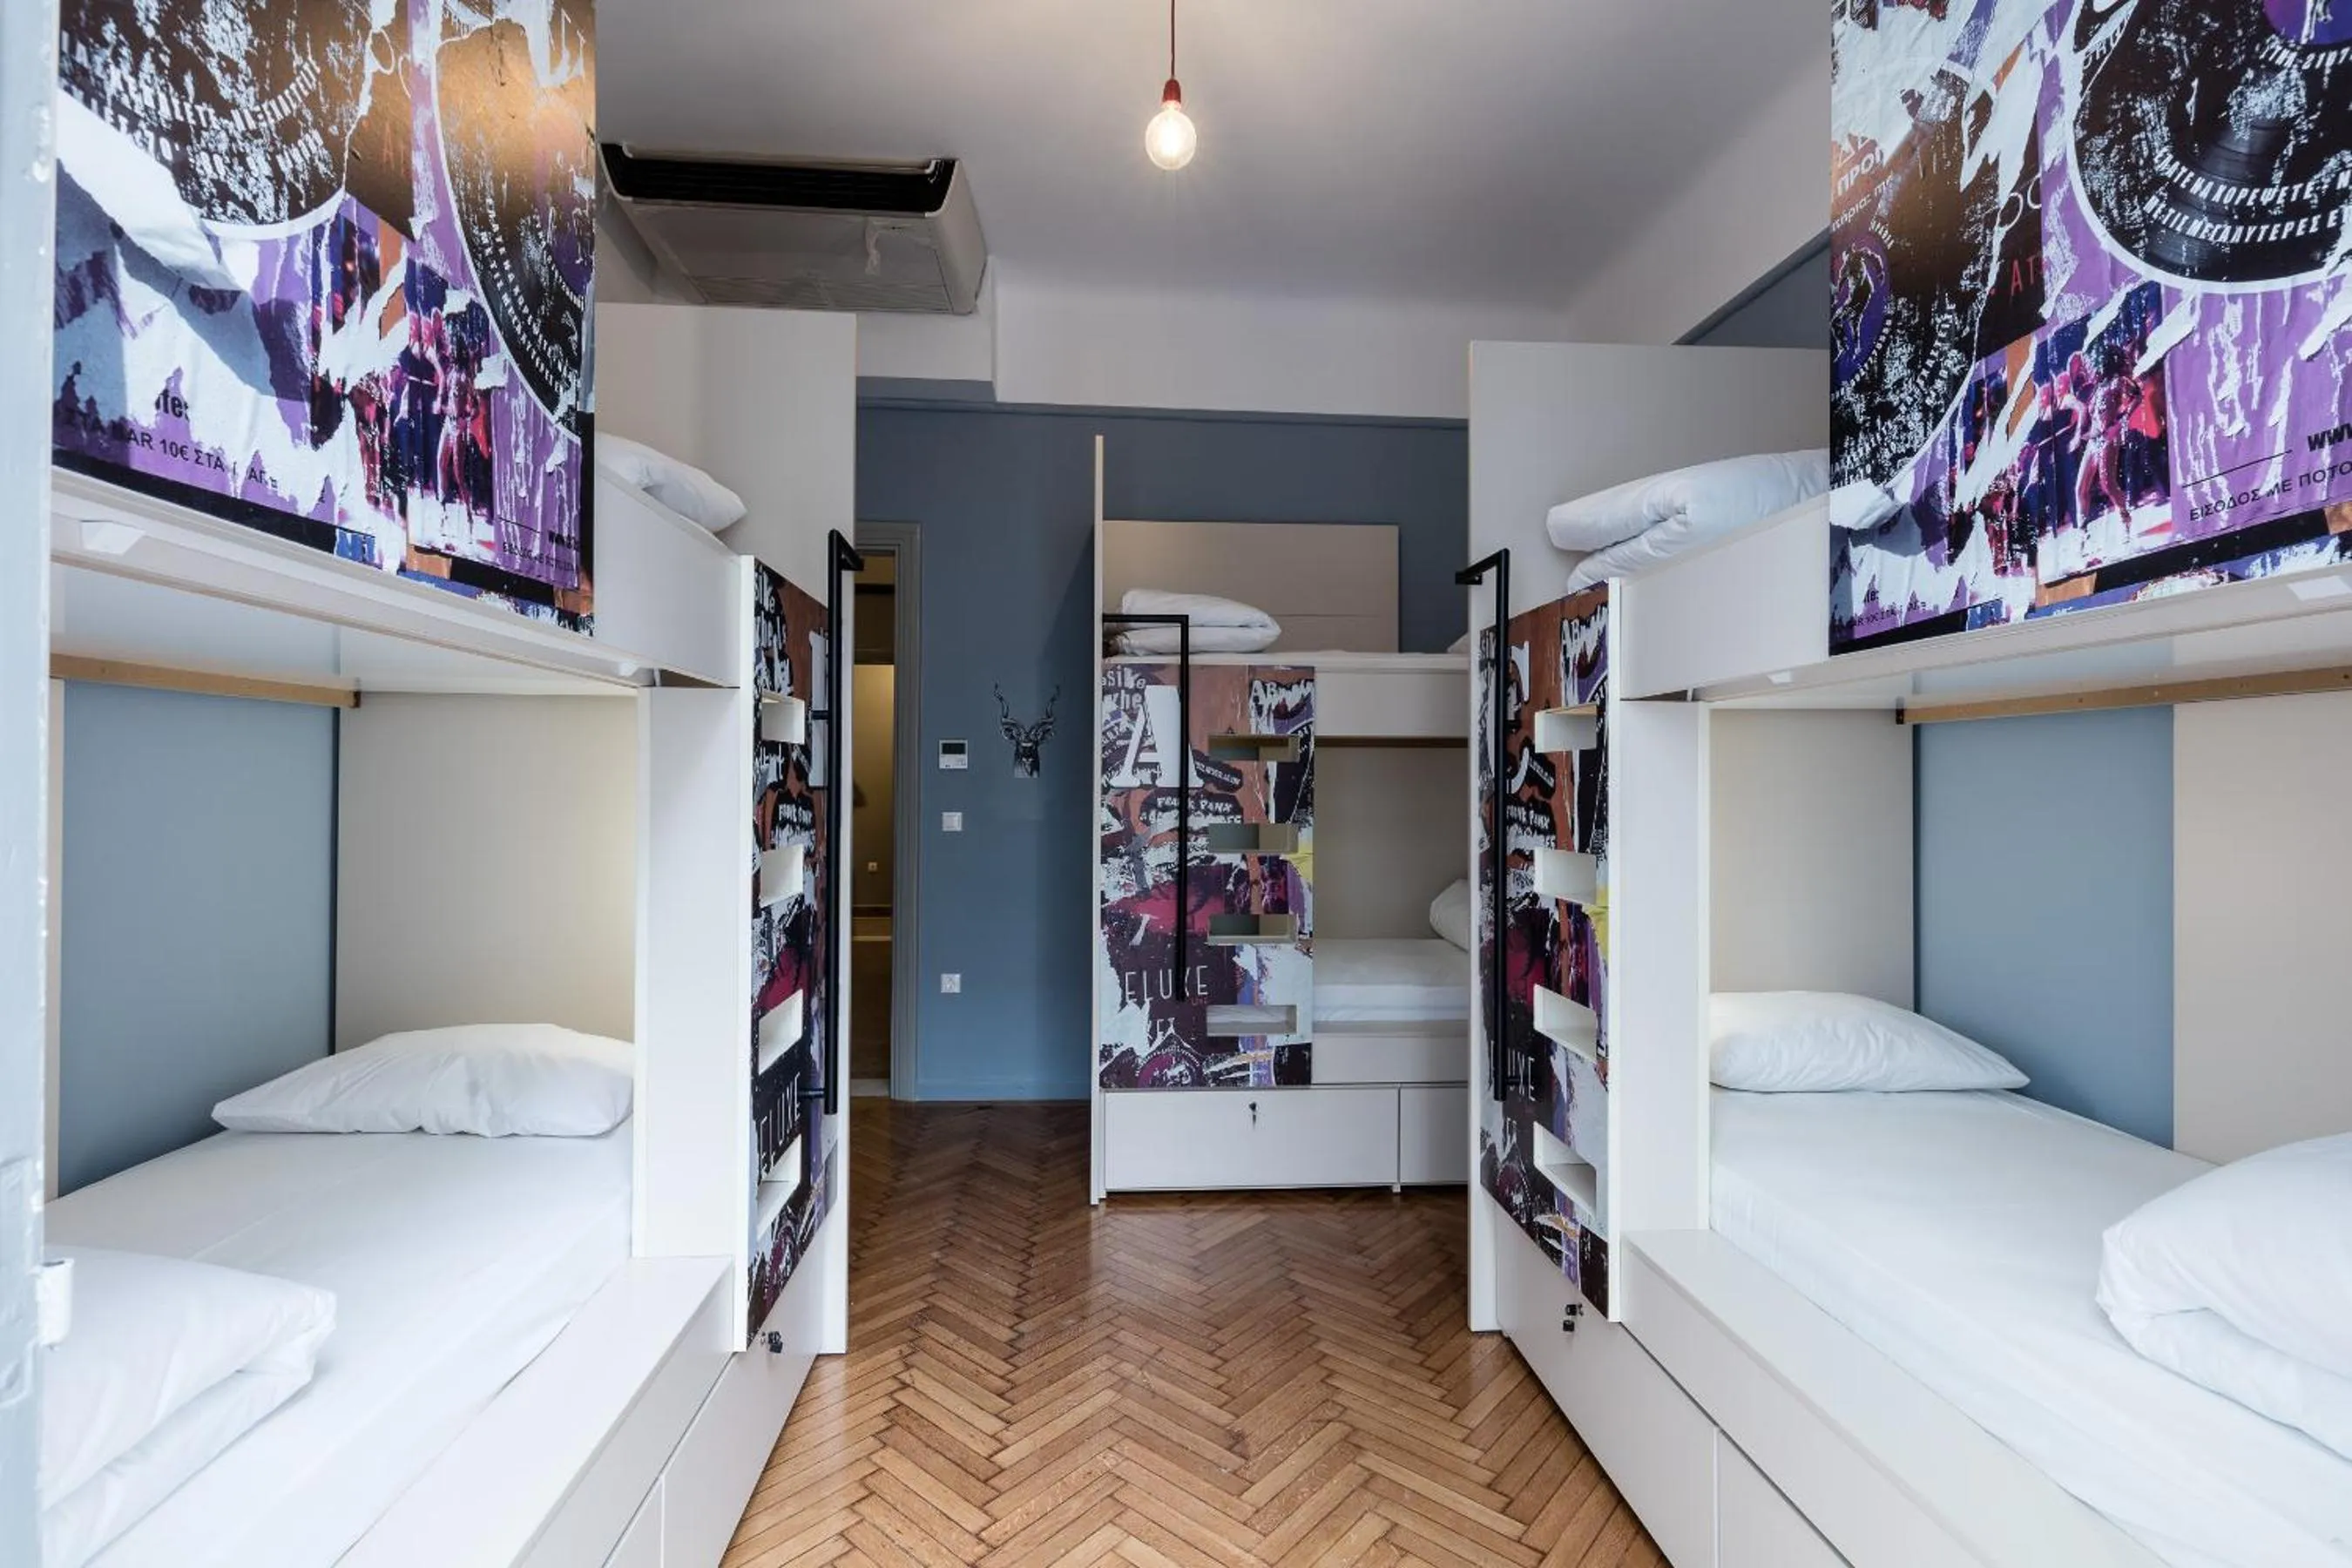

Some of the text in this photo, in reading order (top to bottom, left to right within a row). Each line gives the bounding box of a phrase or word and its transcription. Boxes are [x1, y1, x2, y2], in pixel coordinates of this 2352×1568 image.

[2189, 176, 2214, 199] ΝΑ
[2161, 207, 2190, 233] ΤΙΣ
[159, 439, 189, 463] 10€
[194, 449, 226, 473] ΣΤΑ
[2189, 488, 2262, 522] ΕΙΣΟΔΟΣ
[1110, 684, 1205, 788] A
